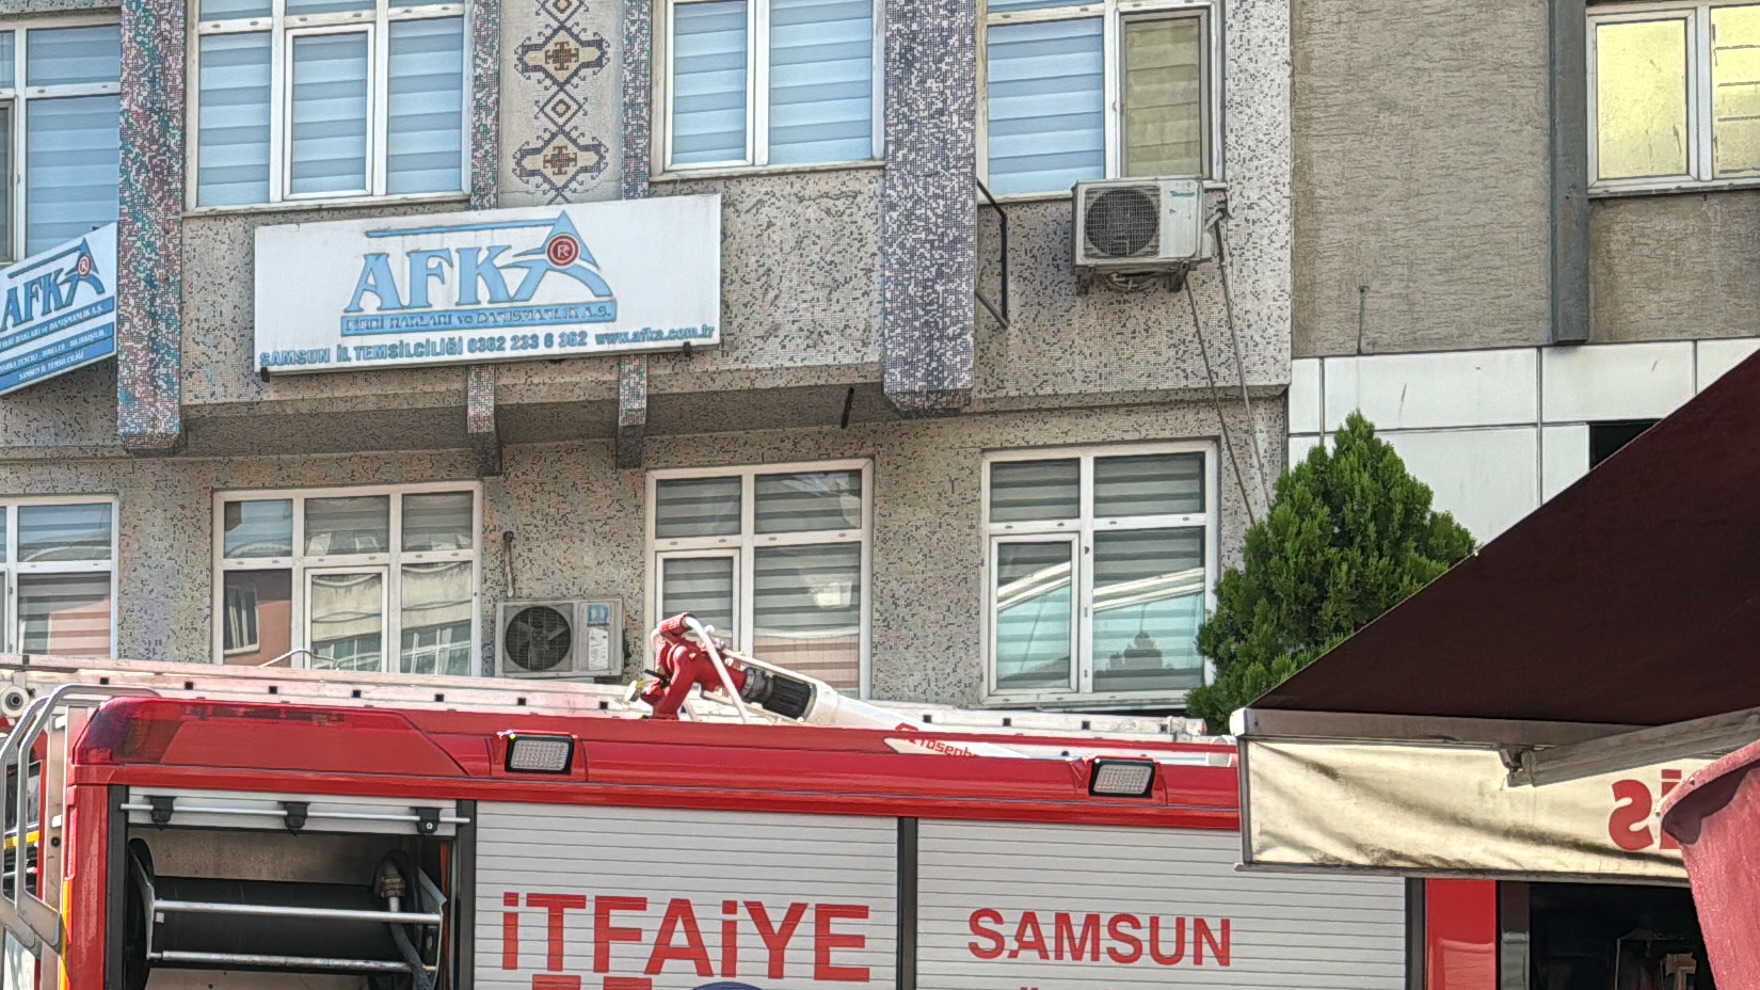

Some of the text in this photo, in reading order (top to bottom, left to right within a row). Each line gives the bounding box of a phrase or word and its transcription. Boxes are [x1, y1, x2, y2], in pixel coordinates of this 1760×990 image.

[0, 237, 106, 333] AFKA
[343, 210, 614, 314] AFKA
[259, 347, 331, 368] SAMSUN
[353, 336, 463, 362] TEMSİLCİLİĞİ
[509, 333, 540, 351] 233
[557, 330, 588, 349] 362
[967, 907, 1231, 967] SAMSUN
